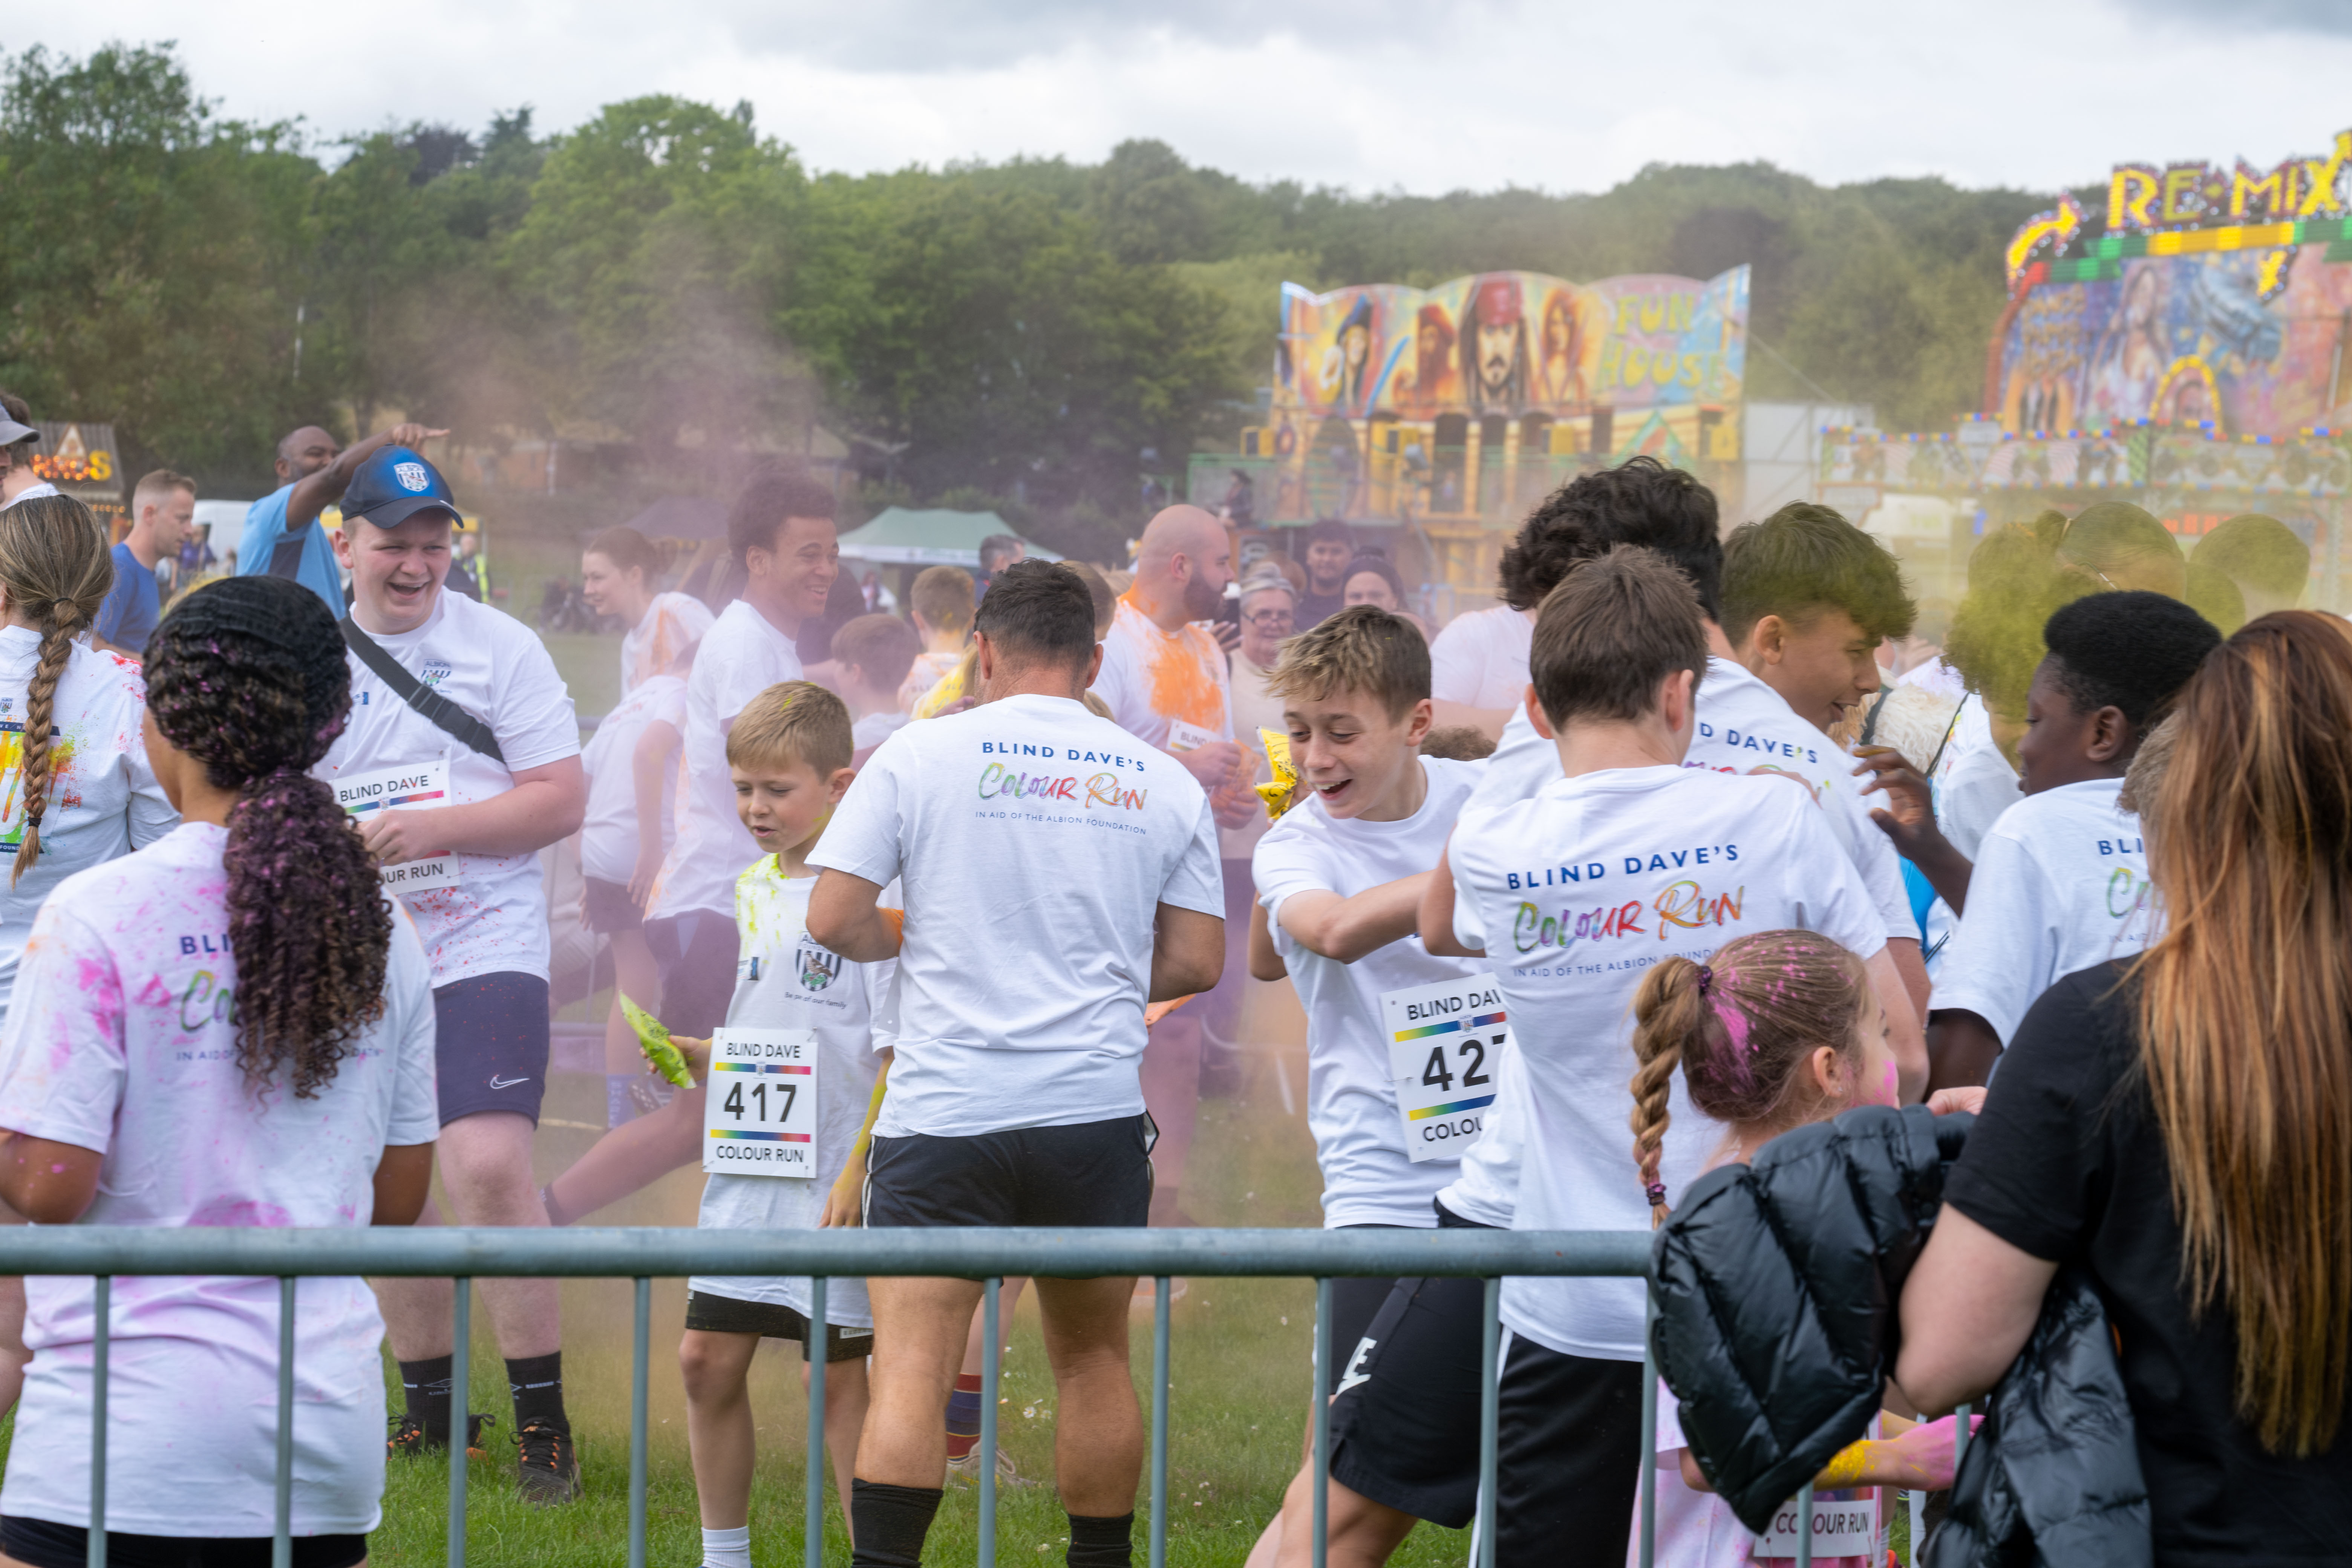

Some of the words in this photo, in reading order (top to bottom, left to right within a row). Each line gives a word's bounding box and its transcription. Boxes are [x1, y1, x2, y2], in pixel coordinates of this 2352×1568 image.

[1615, 292, 1695, 335] FUN
[1595, 334, 1728, 394] HOUSE
[983, 742, 1054, 758] BLIND
[1068, 749, 1144, 771] DAVE'S
[1726, 729, 1818, 764] DAVE'S
[340, 783, 382, 802] BLIND
[388, 775, 429, 792] DAVE
[1086, 819, 1146, 835] FOUNDATION
[2097, 838, 2144, 855] BLI
[410, 863, 443, 879] RUN
[1508, 863, 1605, 889] BLIND
[1625, 845, 1738, 874] DAVE'S
[179, 934, 230, 954] BLI
[1514, 968, 1526, 977] IN
[1531, 968, 1550, 977] AID
[1556, 967, 1572, 976] OF
[1577, 964, 1602, 974] THE
[1607, 956, 1657, 971] ALBION
[825, 999, 847, 1009] family
[1407, 996, 1462, 1020] BLIND
[726, 1042, 762, 1057] BLIND
[766, 1044, 801, 1059] DAVE
[1423, 1034, 1506, 1092] 42
[724, 1081, 797, 1122] 417
[717, 1145, 772, 1162] COLOUR
[776, 1148, 804, 1163] RUN
[1776, 1512, 1845, 1534] COOUR
[1848, 1512, 1869, 1533] RUN
